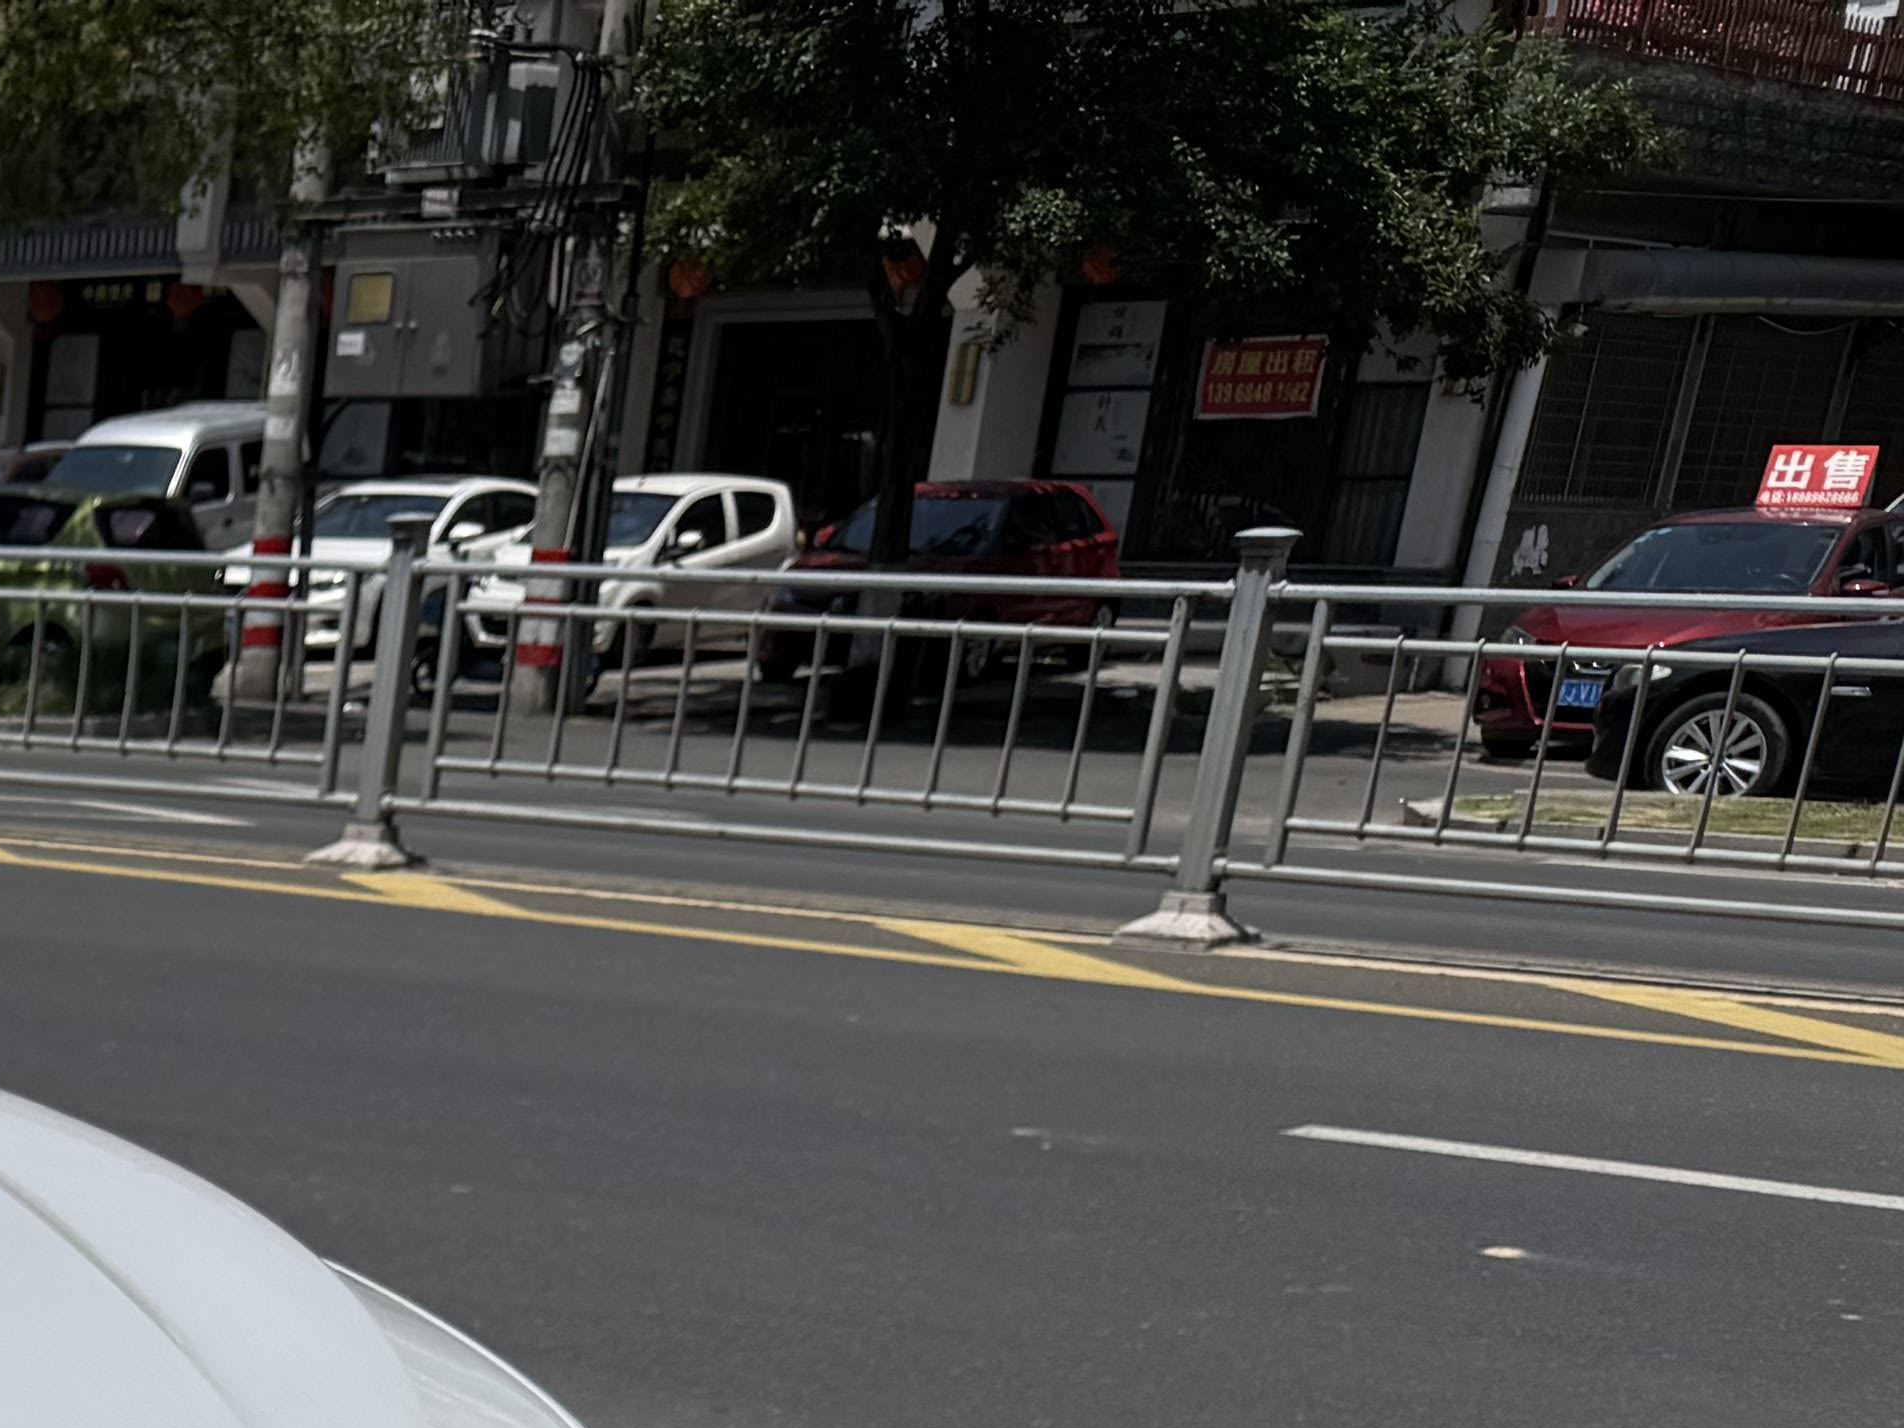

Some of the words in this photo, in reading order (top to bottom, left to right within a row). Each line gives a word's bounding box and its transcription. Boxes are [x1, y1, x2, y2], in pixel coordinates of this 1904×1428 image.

[1211, 349, 1319, 375] 房屋出租
[1766, 450, 1870, 490] 出售
